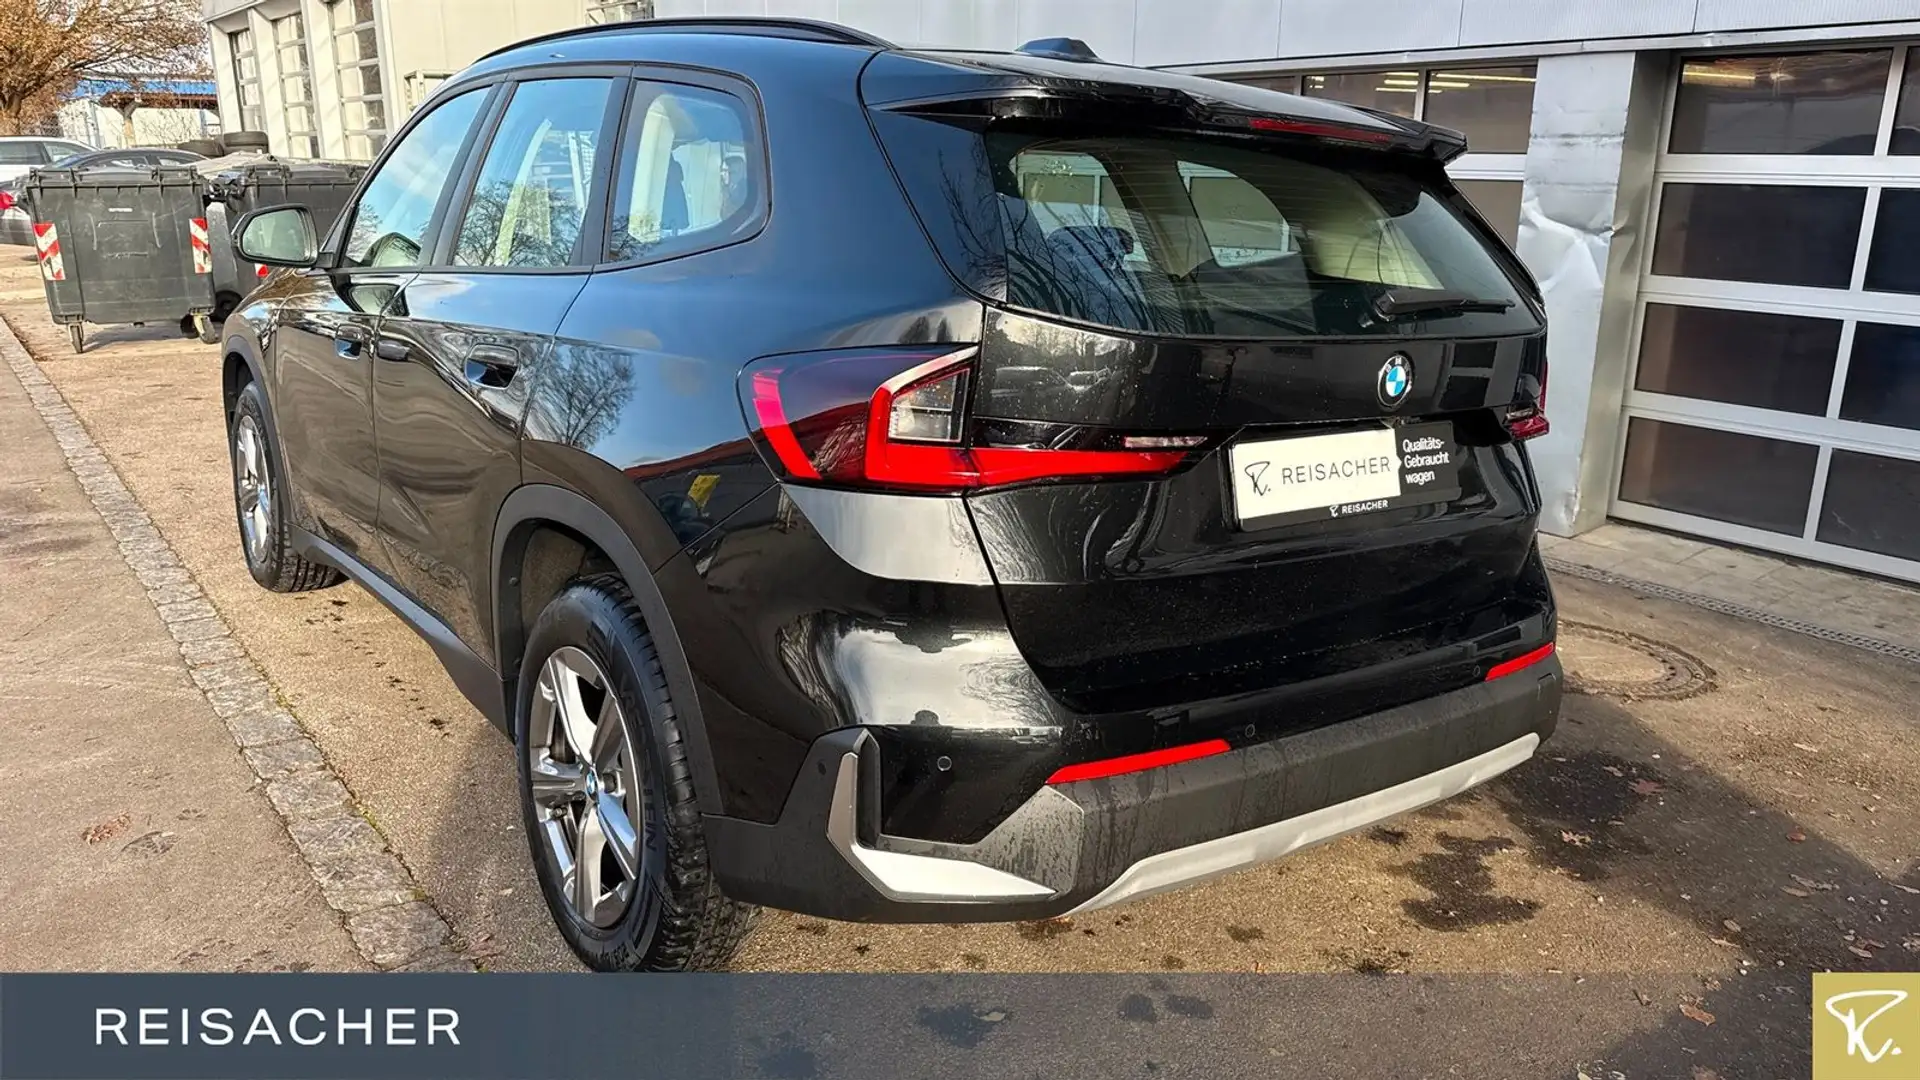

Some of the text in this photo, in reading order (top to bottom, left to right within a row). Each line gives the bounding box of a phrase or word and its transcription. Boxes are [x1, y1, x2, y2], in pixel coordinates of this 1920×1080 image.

[1402, 436, 1445, 453] Qualitäts-
[1403, 451, 1450, 469] Gebraucht
[1282, 456, 1391, 485] REISACHER
[1405, 470, 1436, 486] wagen
[1341, 499, 1389, 514] REISACHER
